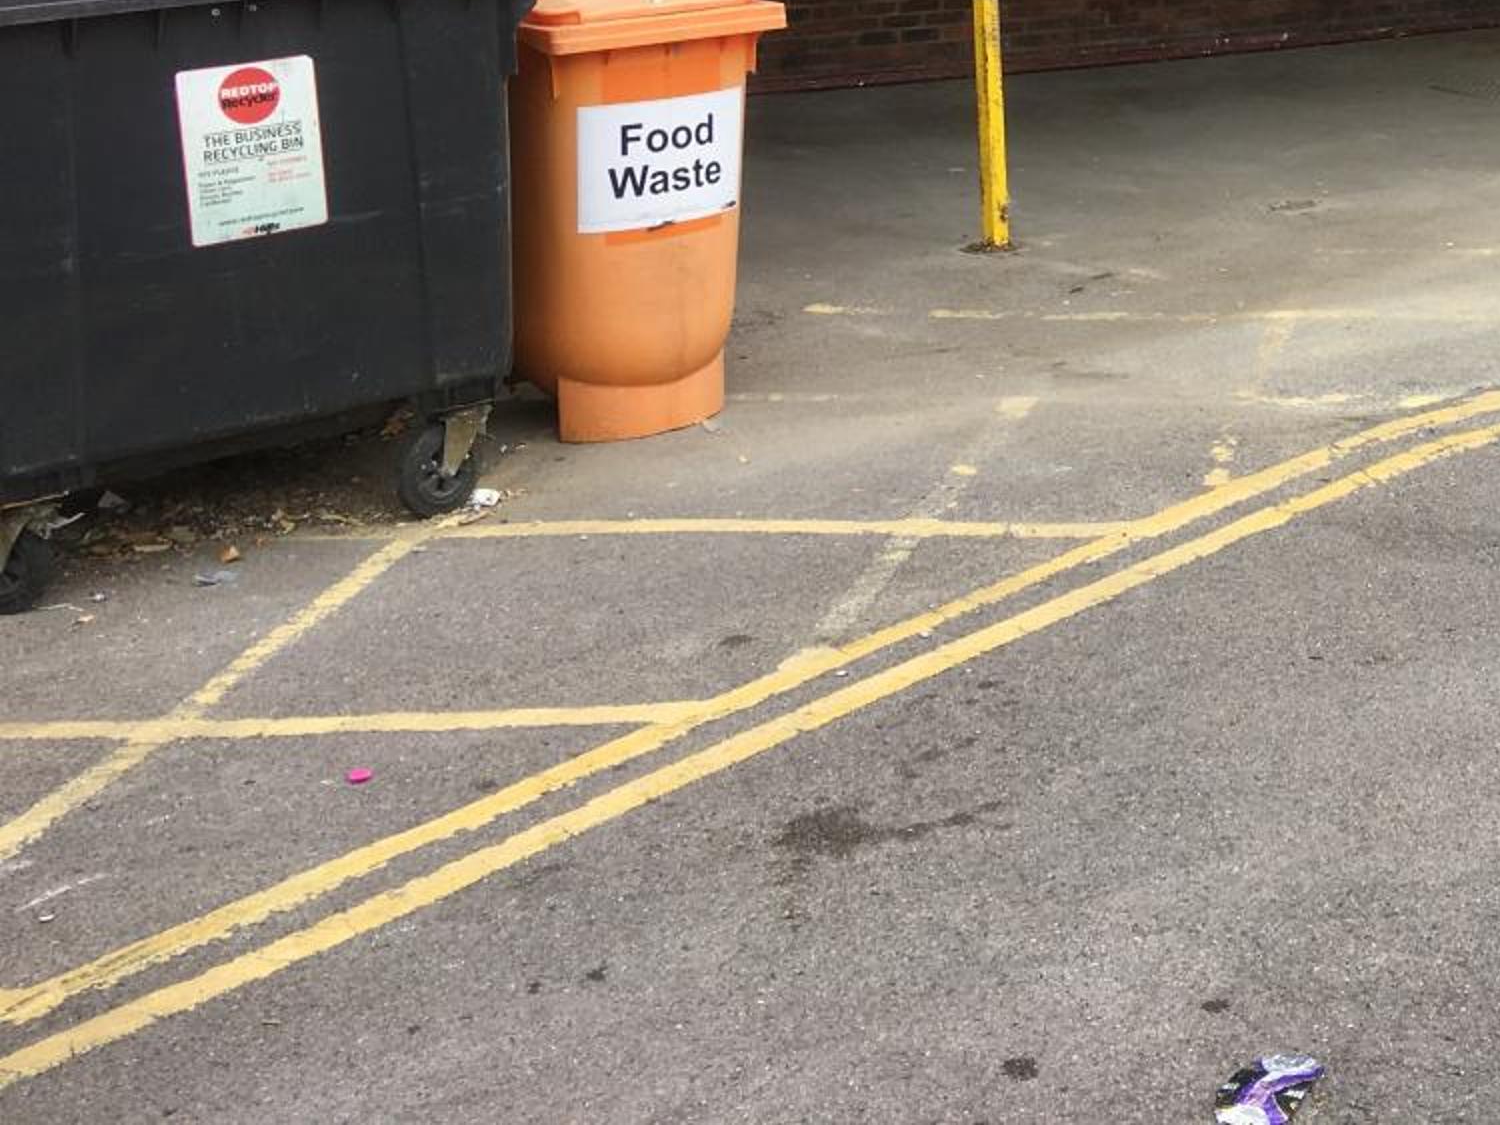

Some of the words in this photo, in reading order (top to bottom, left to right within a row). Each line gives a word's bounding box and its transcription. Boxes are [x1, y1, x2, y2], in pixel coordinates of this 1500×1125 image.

[203, 135, 231, 148] THE
[235, 123, 302, 144] BUSINESS
[203, 141, 277, 163] RECYCLING
[281, 136, 304, 150] BIN
[621, 113, 713, 156] Food
[608, 158, 721, 199] Waste
